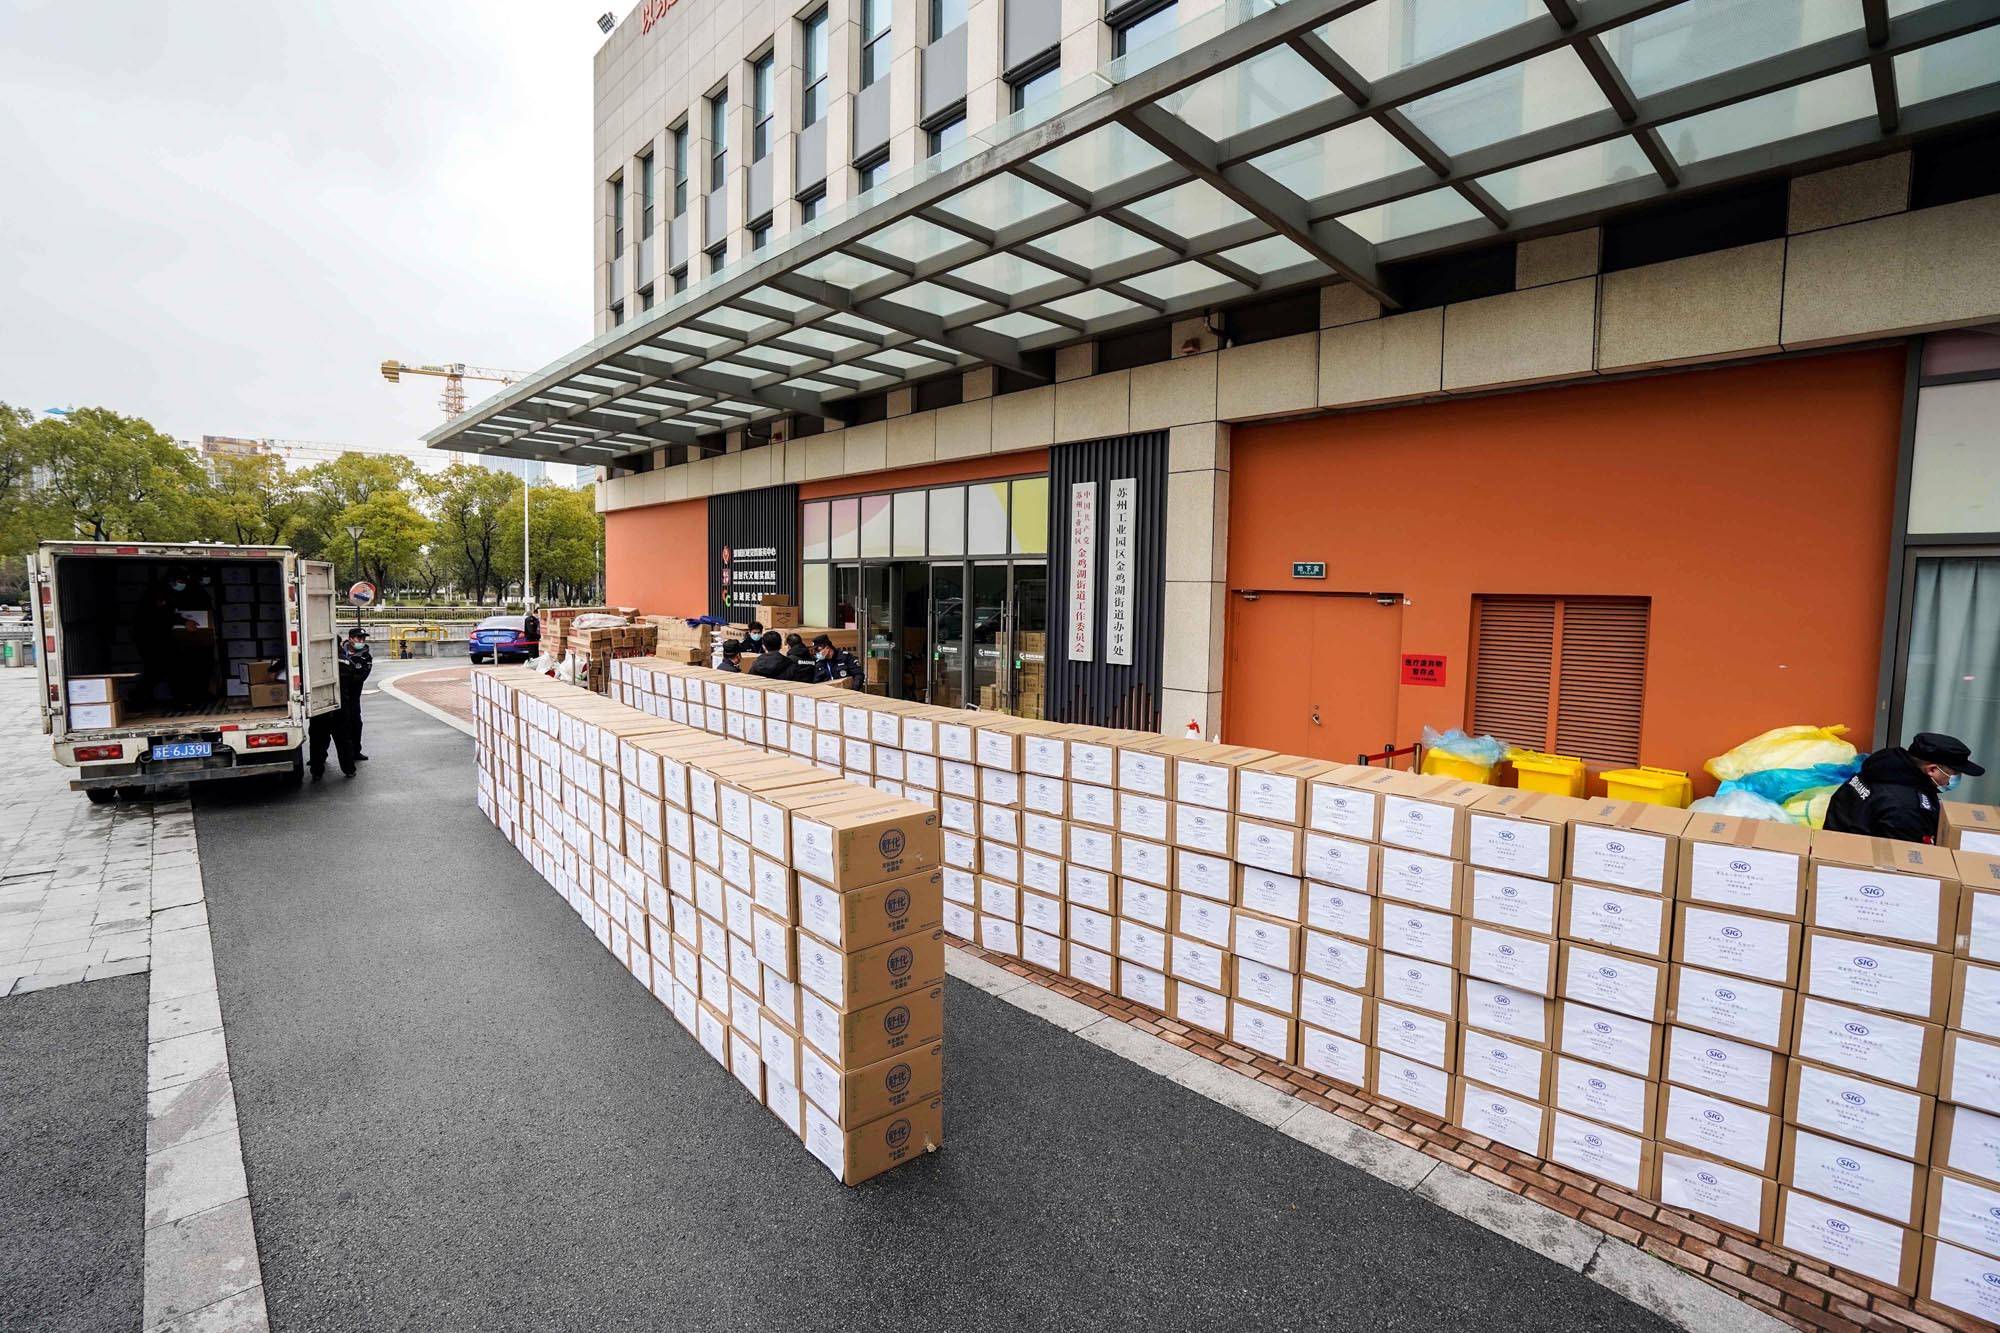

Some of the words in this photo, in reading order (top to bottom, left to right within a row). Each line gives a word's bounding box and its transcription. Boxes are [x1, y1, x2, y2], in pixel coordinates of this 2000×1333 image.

[1074, 491, 1083, 545] 苏州工业园区
[1082, 490, 1091, 545] 中国共产党
[1113, 487, 1128, 656] 苏州工业园区金鸡湖街道办事处
[1075, 547, 1087, 653] 金鸡湖街道工作委员会
[1733, 862, 1747, 870] SIG
[1863, 887, 1880, 896] SIG
[1724, 928, 1739, 937] SIG
[1857, 958, 1873, 967] SIG
[1718, 990, 1732, 999] SIG
[1847, 1025, 1864, 1034] SIG
[1709, 1050, 1723, 1059] SIG
[1845, 1093, 1861, 1103] SIG
[1707, 1111, 1720, 1120] SIG
[1840, 1159, 1856, 1169] SIG
[1699, 1174, 1714, 1183] SIG
[1829, 1220, 1846, 1231] SIG
